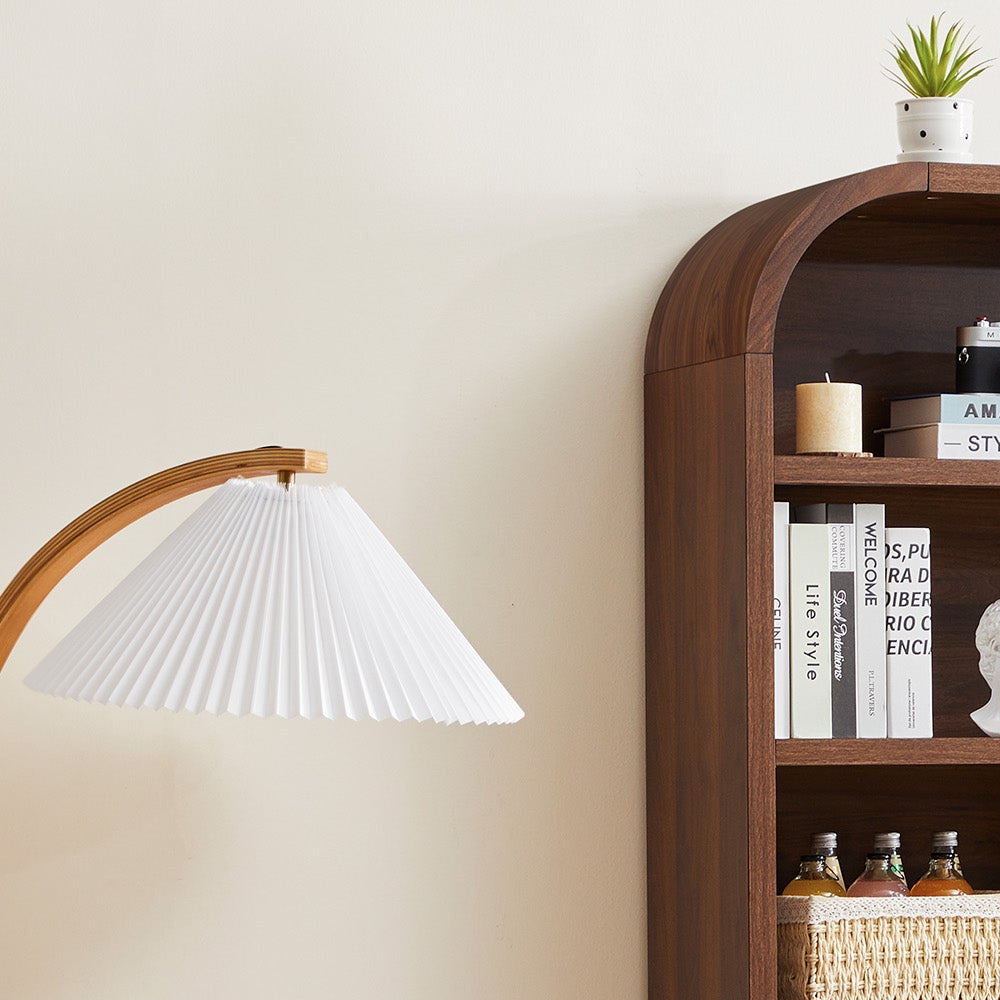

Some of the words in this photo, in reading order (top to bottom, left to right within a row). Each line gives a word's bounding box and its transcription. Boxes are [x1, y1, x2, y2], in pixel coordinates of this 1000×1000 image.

[865, 522, 878, 606] WELCOME
[806, 584, 819, 620] Life
[804, 630, 819, 681] Style
